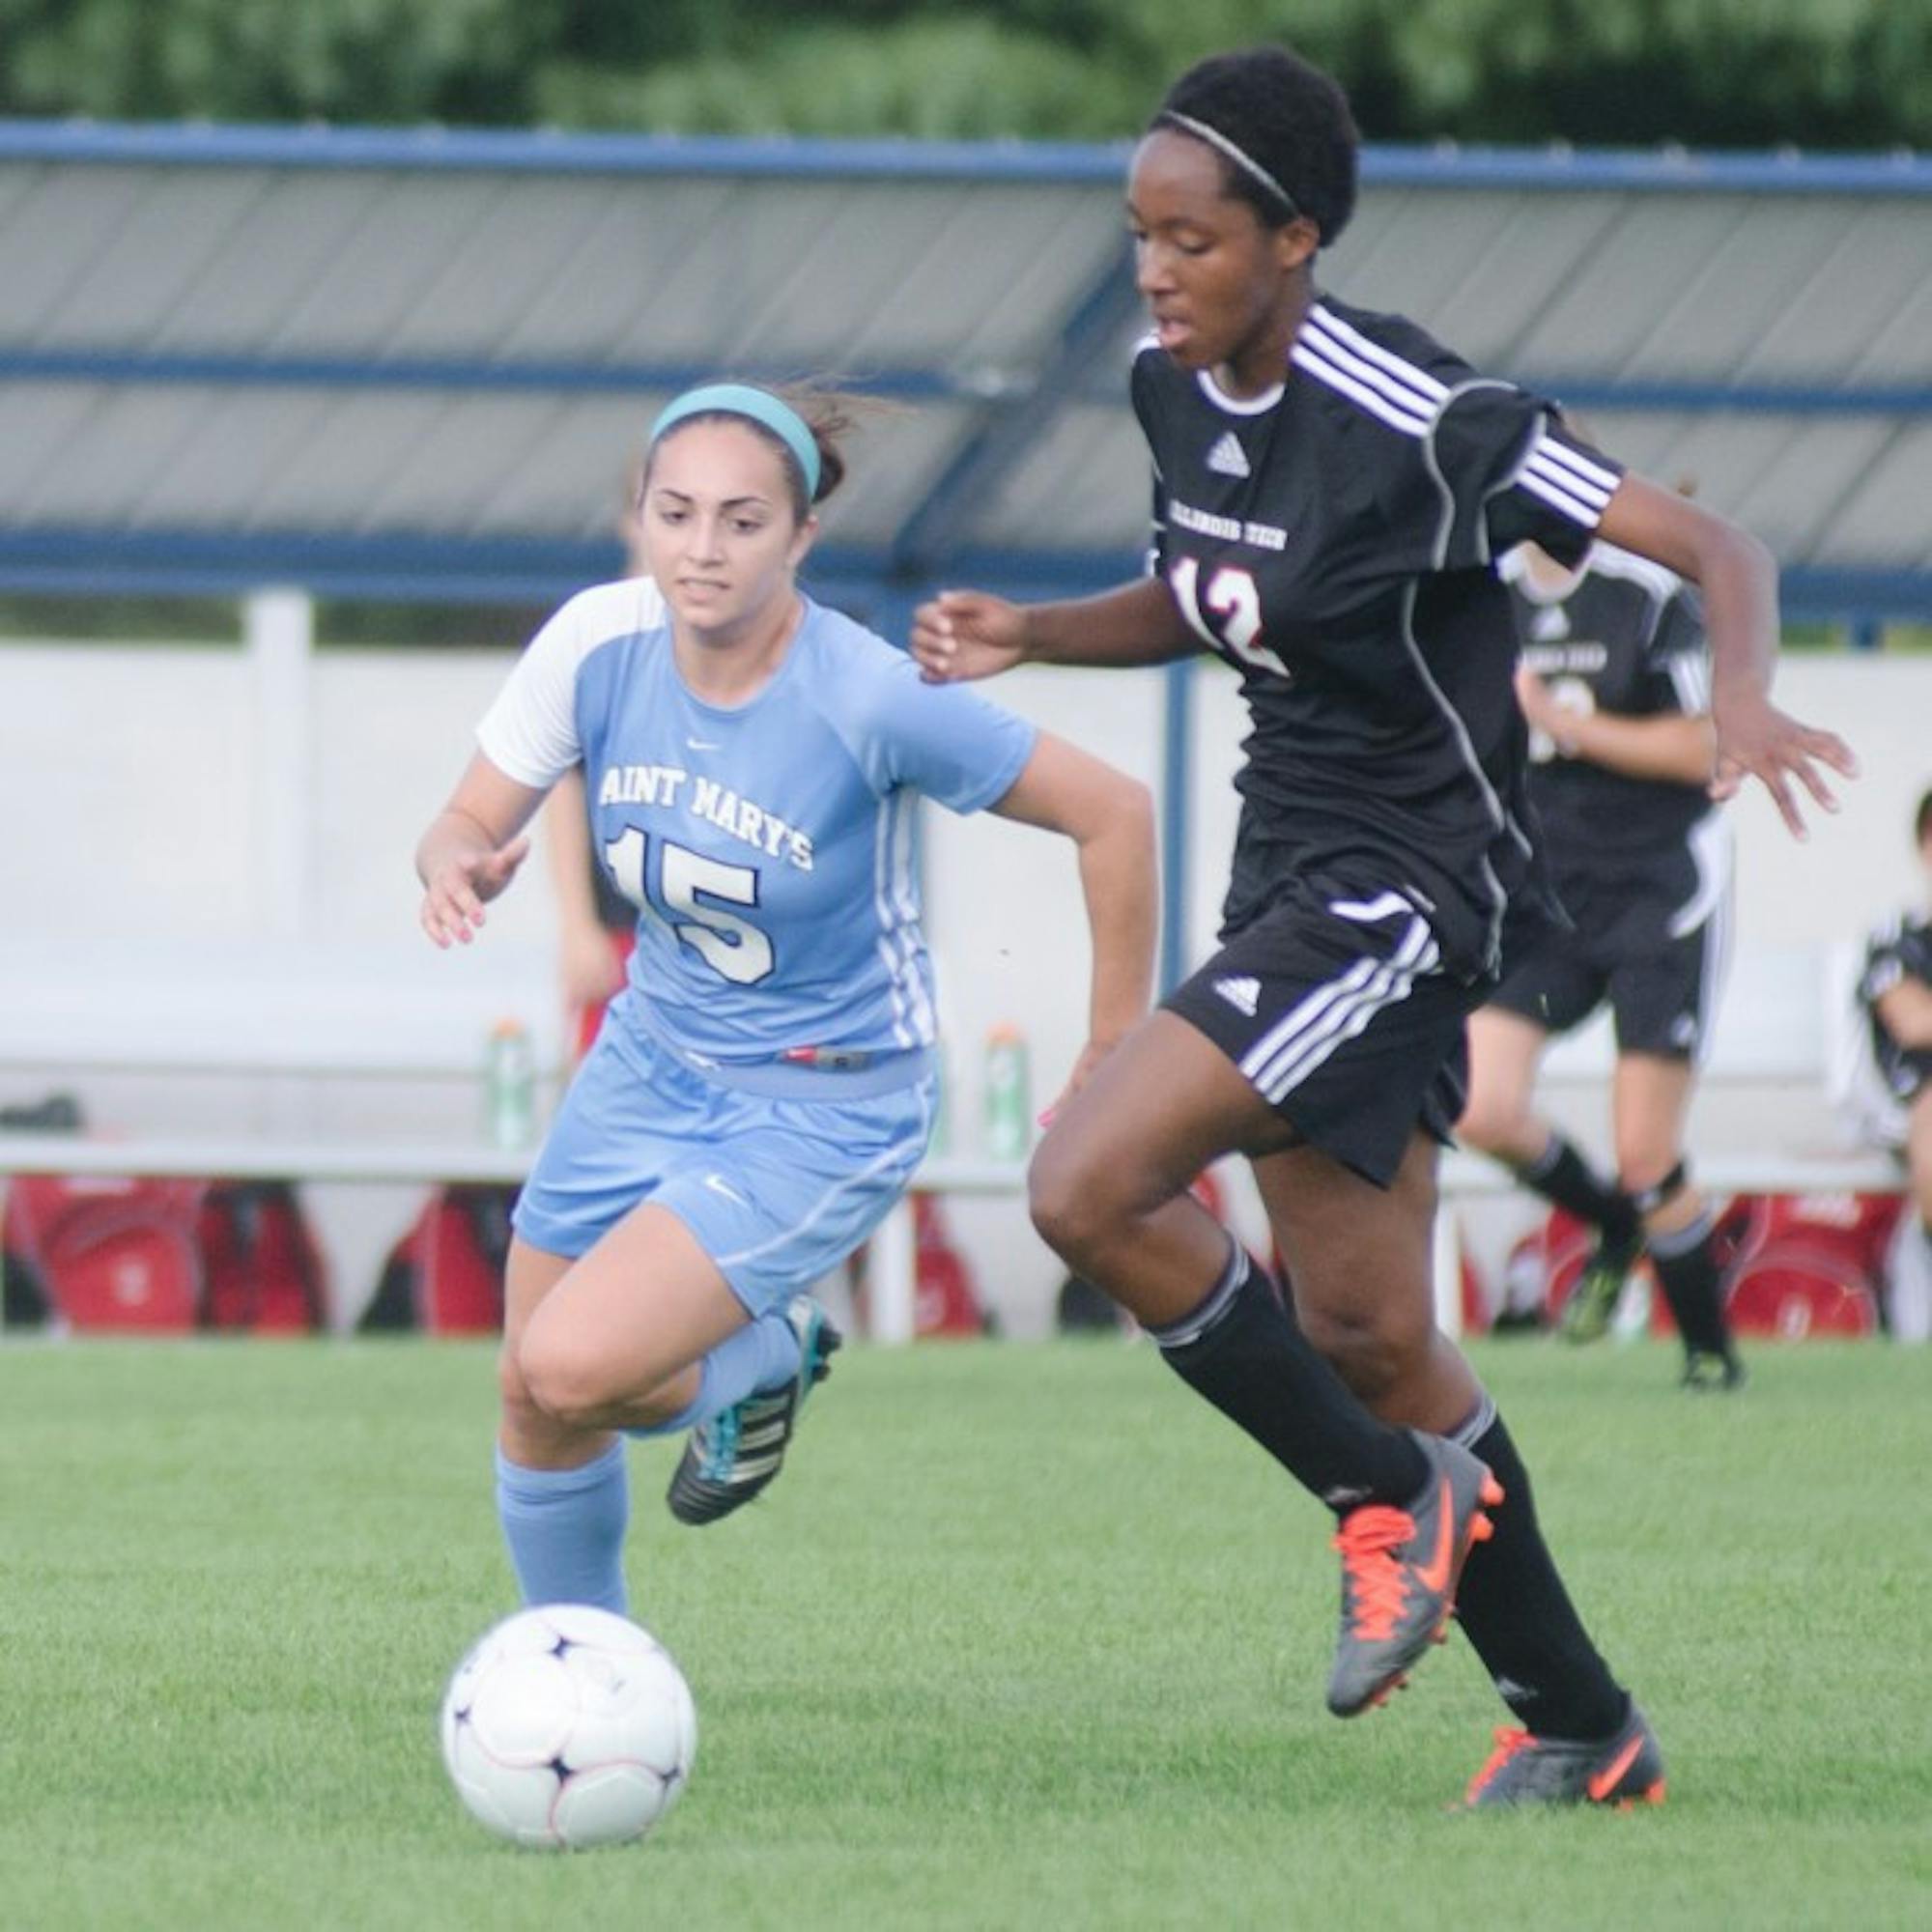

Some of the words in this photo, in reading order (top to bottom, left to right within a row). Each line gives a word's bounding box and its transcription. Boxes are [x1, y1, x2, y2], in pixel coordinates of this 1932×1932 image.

[1170, 556, 1291, 677] 12
[599, 766, 687, 807] AINT
[604, 824, 776, 985] 15
